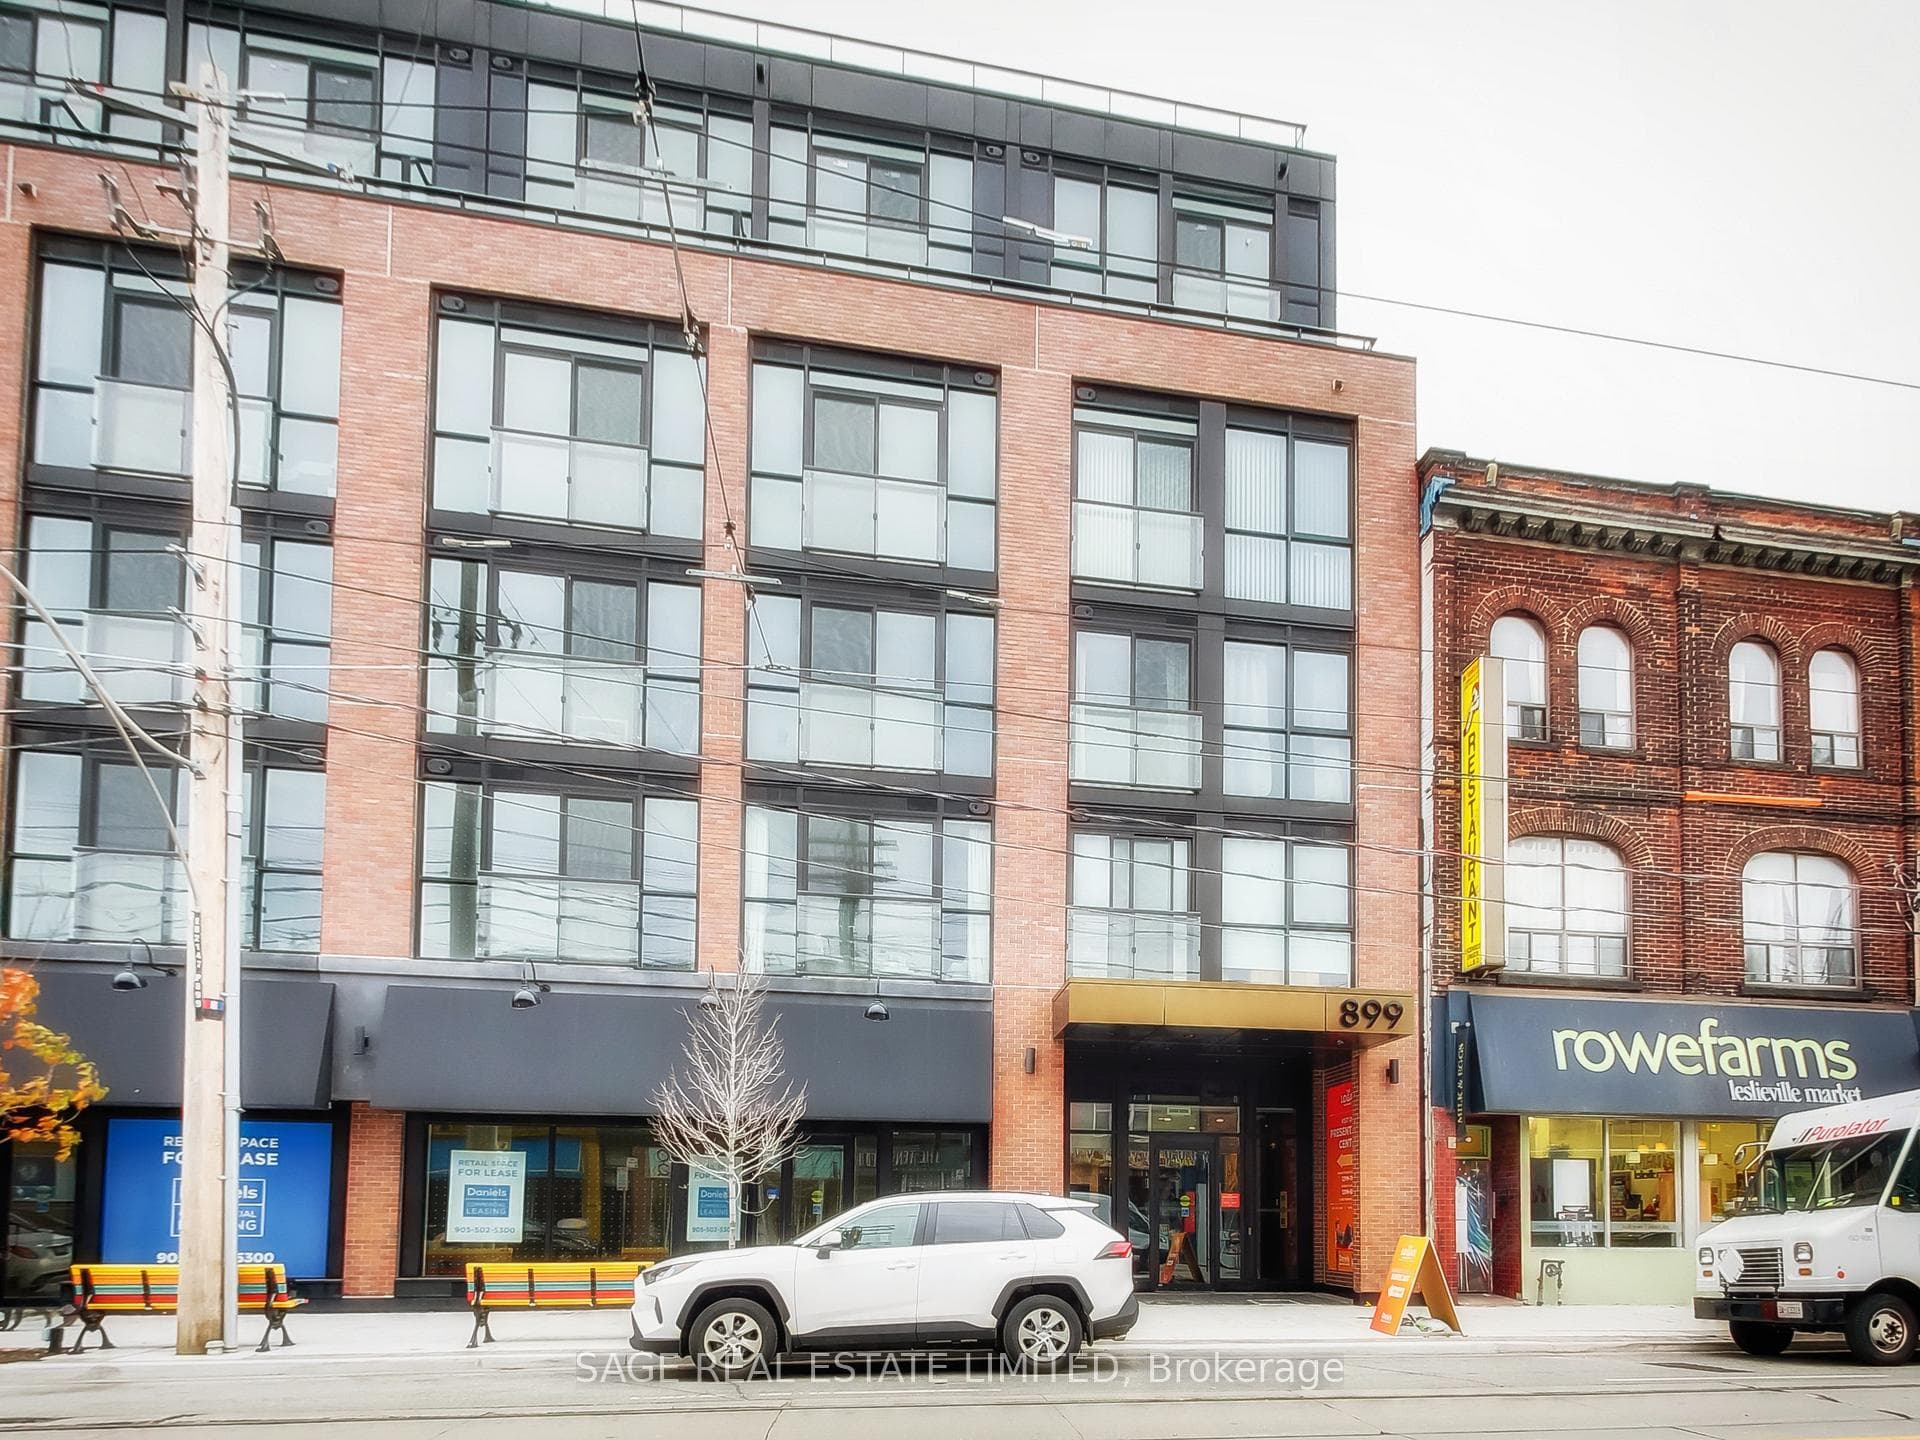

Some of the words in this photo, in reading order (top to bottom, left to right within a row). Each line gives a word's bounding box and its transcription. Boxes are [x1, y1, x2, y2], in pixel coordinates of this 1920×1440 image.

[1467, 732, 1478, 943] RESTAURANT
[1340, 998, 1404, 1030] 899
[1552, 1017, 1857, 1081] rowefarms
[1728, 1080, 1802, 1102] leslieville
[1804, 1083, 1861, 1103] market
[1330, 1125, 1352, 1139] PRESENT
[1806, 1118, 1890, 1142] Purolator
[240, 1137, 279, 1148] PACE
[1339, 1138, 1352, 1149] CENT
[240, 1152, 278, 1165] ASE
[458, 1168, 480, 1176] FOR
[484, 1169, 518, 1178] LEASE
[467, 1187, 507, 1197] Daniels
[466, 1207, 506, 1215] LEASING
